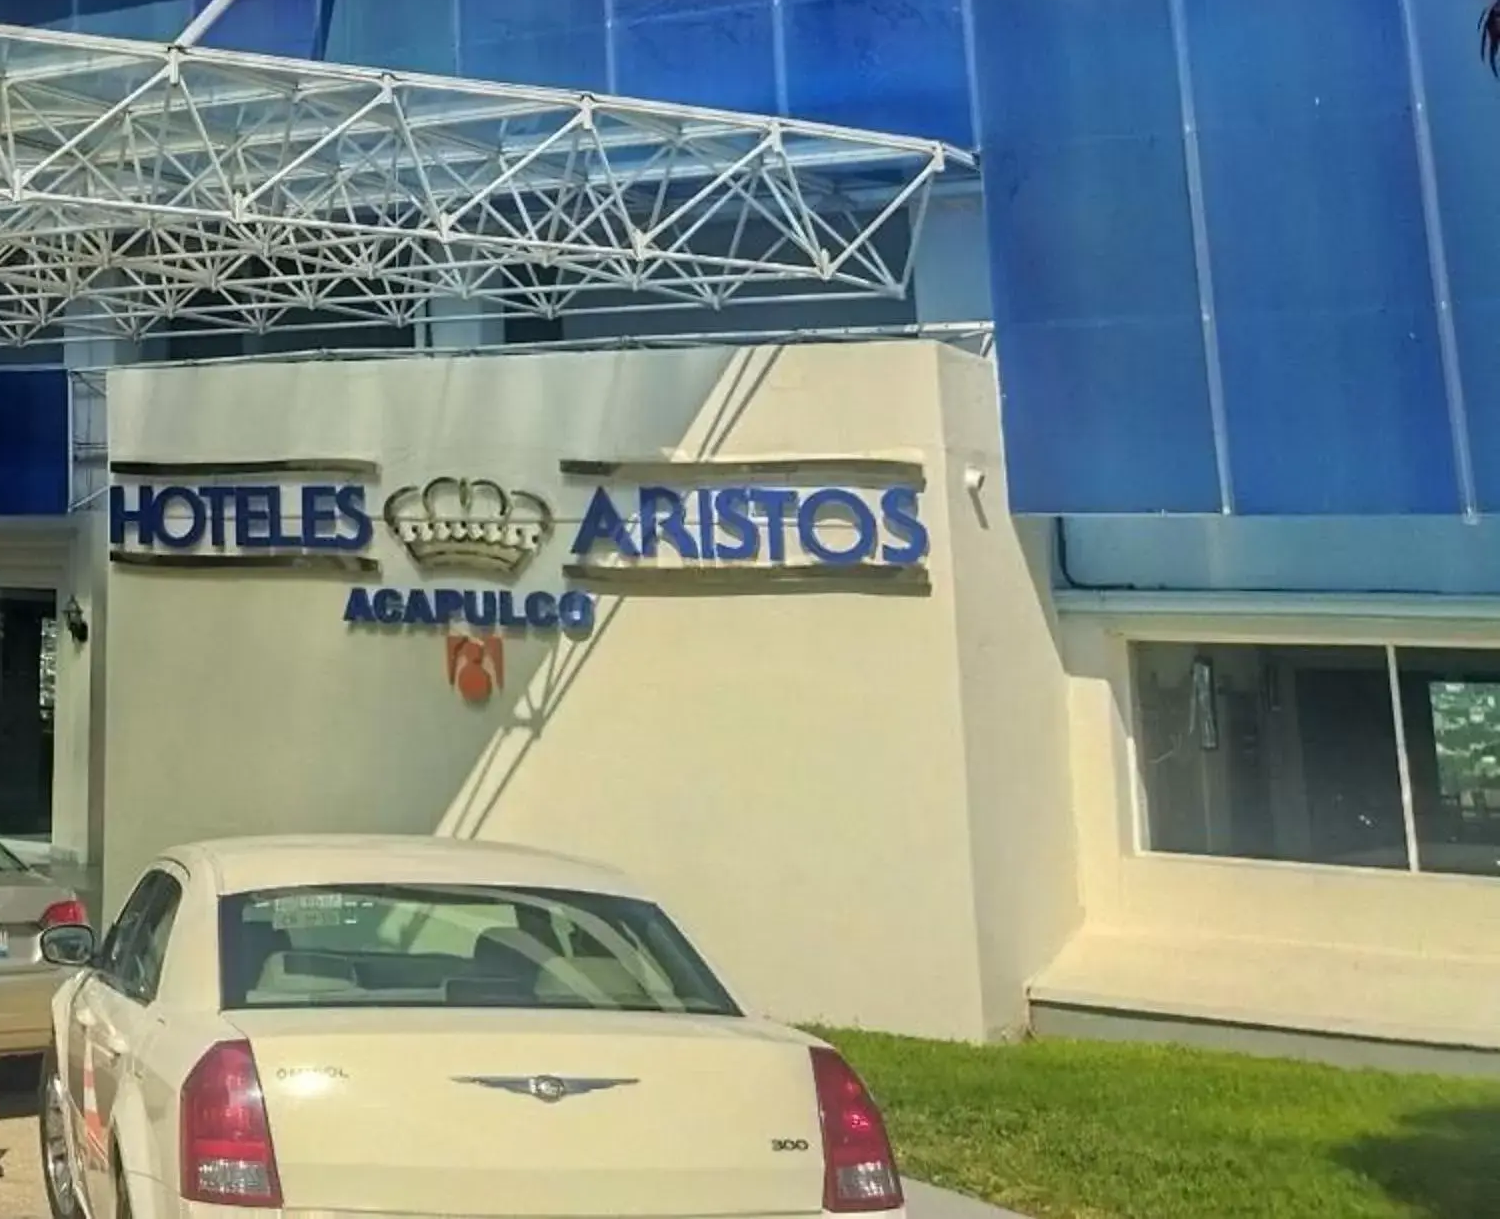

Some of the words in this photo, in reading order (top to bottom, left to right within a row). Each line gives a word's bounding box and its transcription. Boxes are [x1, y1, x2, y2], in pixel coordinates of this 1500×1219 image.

[109, 485, 373, 549] HOTELES
[570, 485, 929, 564] ARISTOS
[343, 587, 593, 631] ACAPULCO
[771, 1139, 809, 1151] 300
